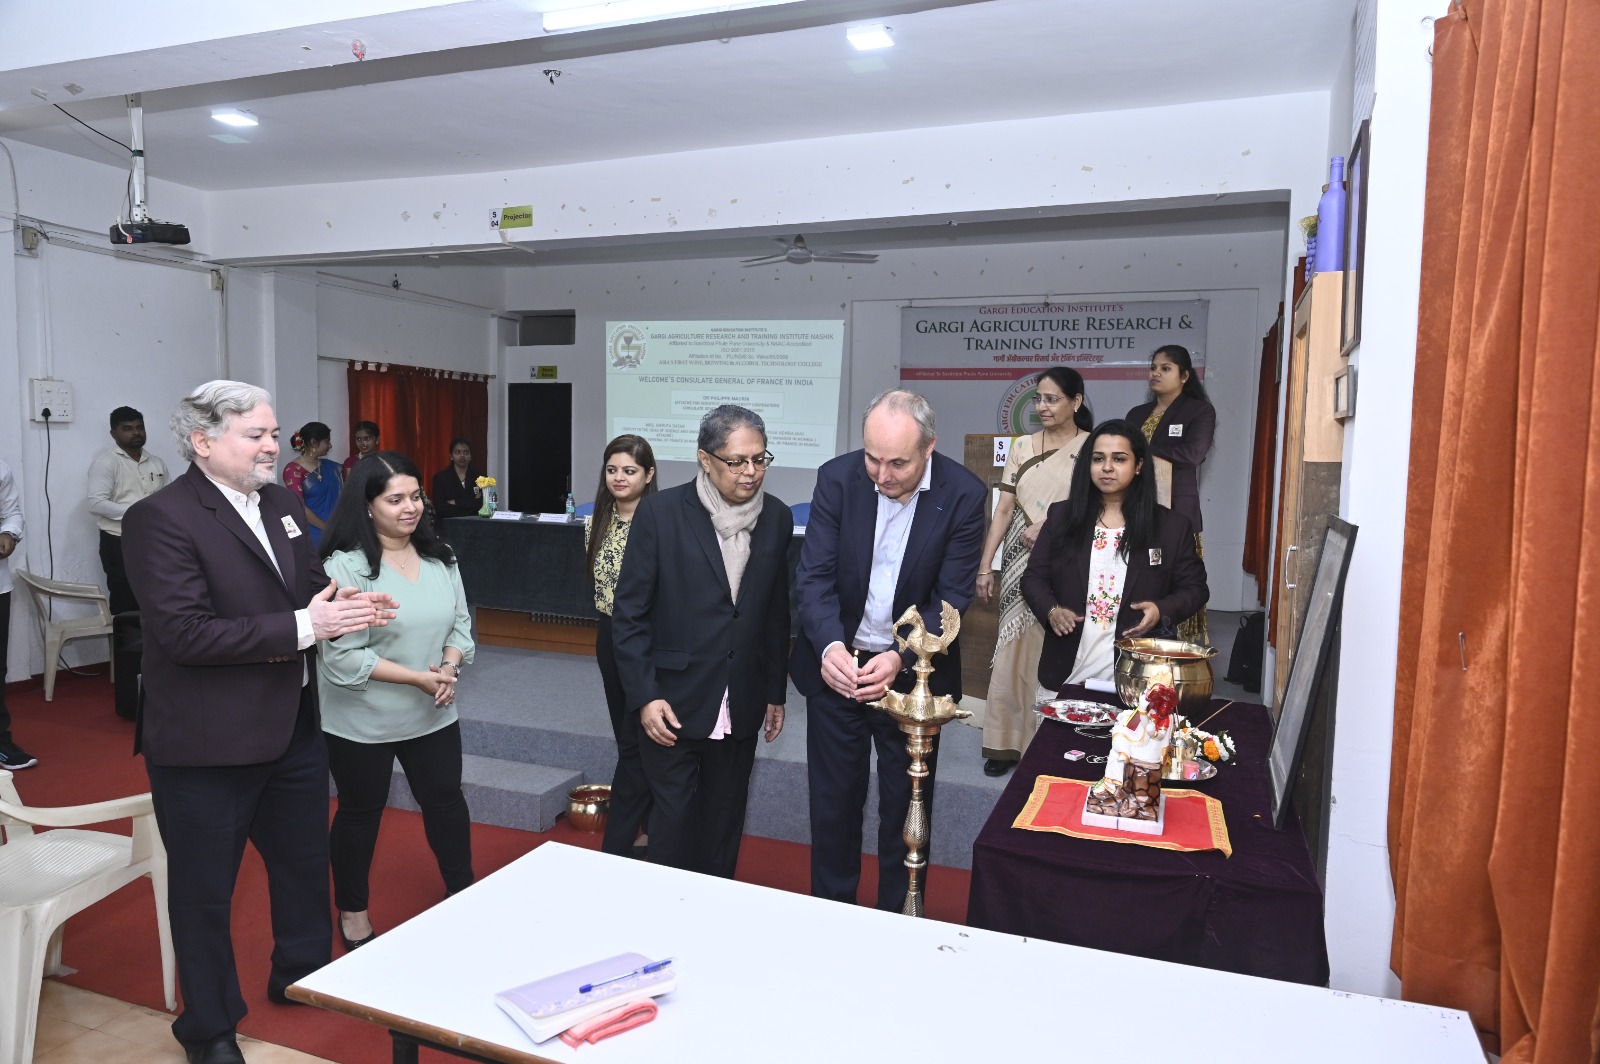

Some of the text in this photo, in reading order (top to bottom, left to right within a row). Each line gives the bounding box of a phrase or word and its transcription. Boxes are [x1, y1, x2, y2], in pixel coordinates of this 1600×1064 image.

[1011, 306, 1064, 314] EDUCATION
[1068, 304, 1124, 313] INSTITUTE'S
[916, 314, 1193, 334] GARGI AGRICULTURE RESEARCH &
[964, 336, 1135, 350] TRAINING INSTITUTE
[1002, 377, 1038, 434] ARGI EDUCATIO
[998, 441, 1004, 450] S
[996, 454, 1006, 462] 04
